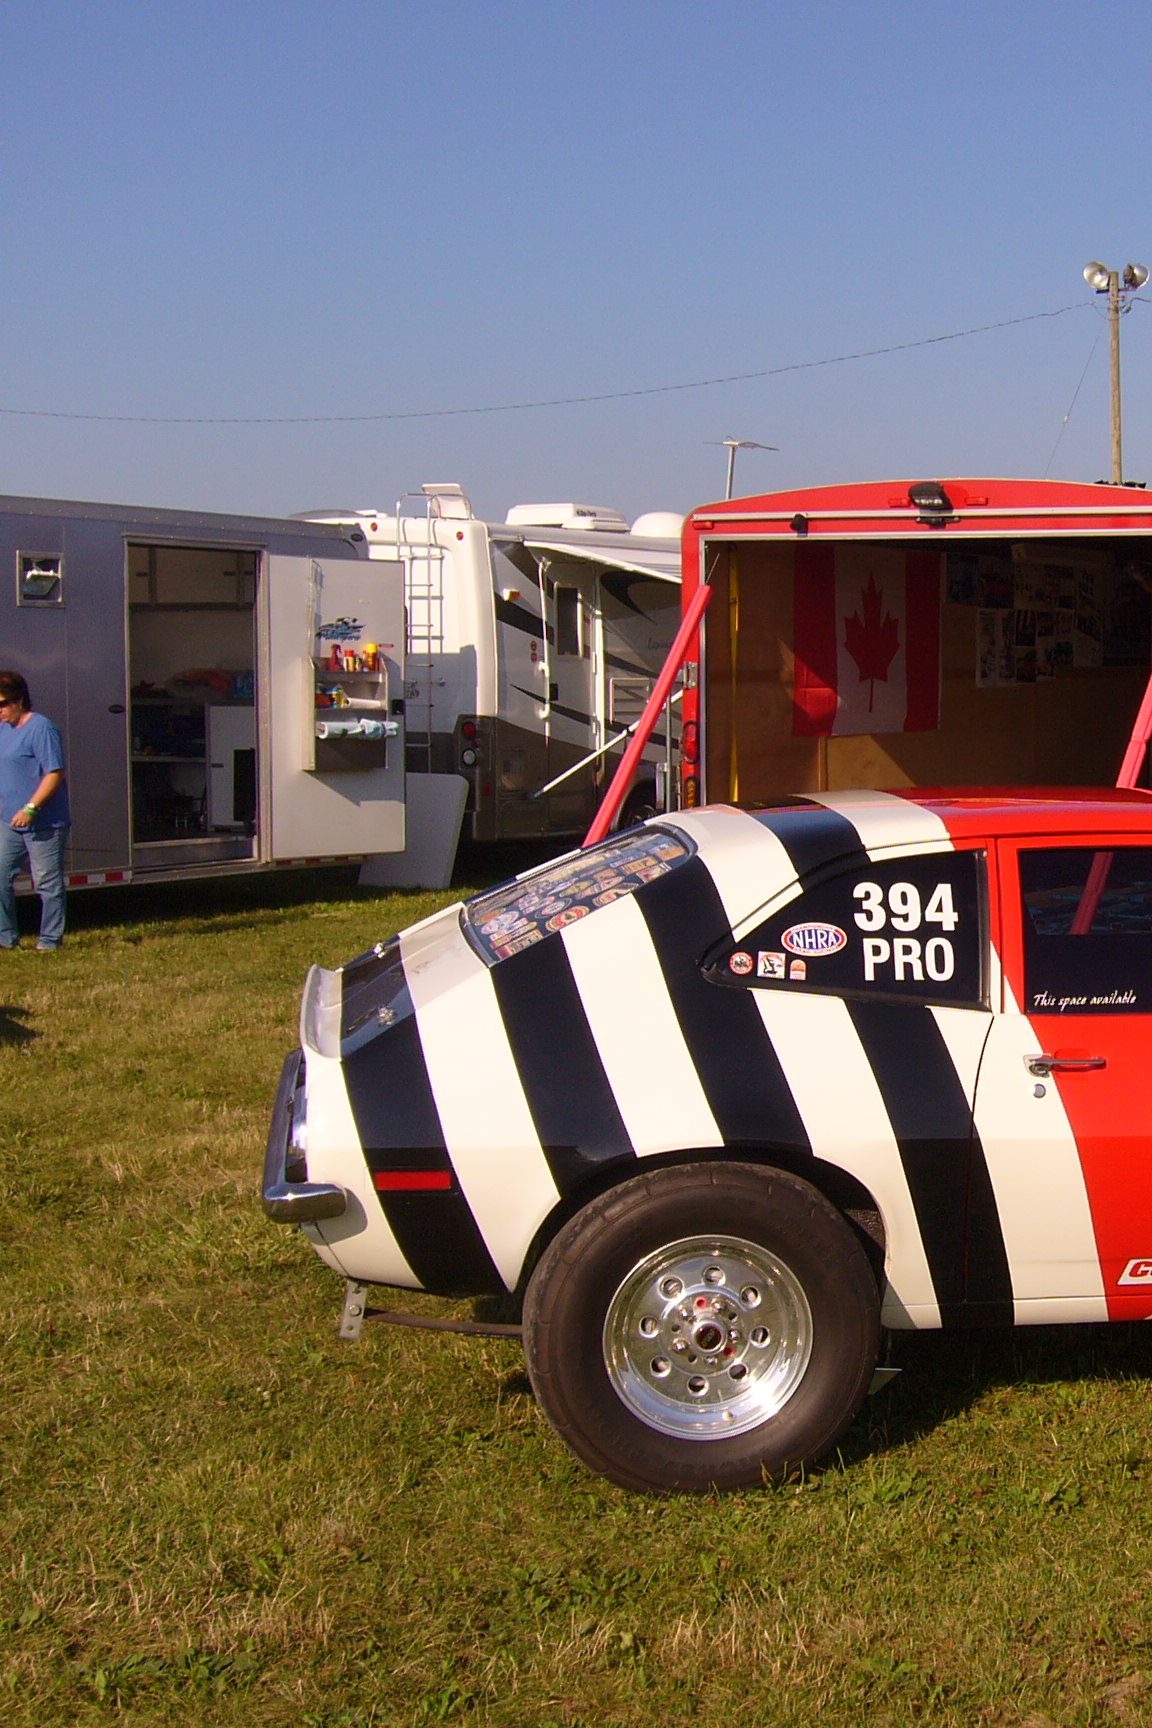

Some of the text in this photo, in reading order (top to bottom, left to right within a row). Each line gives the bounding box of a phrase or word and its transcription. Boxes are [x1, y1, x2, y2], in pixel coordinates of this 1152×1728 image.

[852, 881, 959, 933] 394
[793, 929, 837, 950] NHRA
[862, 937, 955, 982] PRO
[1033, 990, 1137, 1012] This space available
